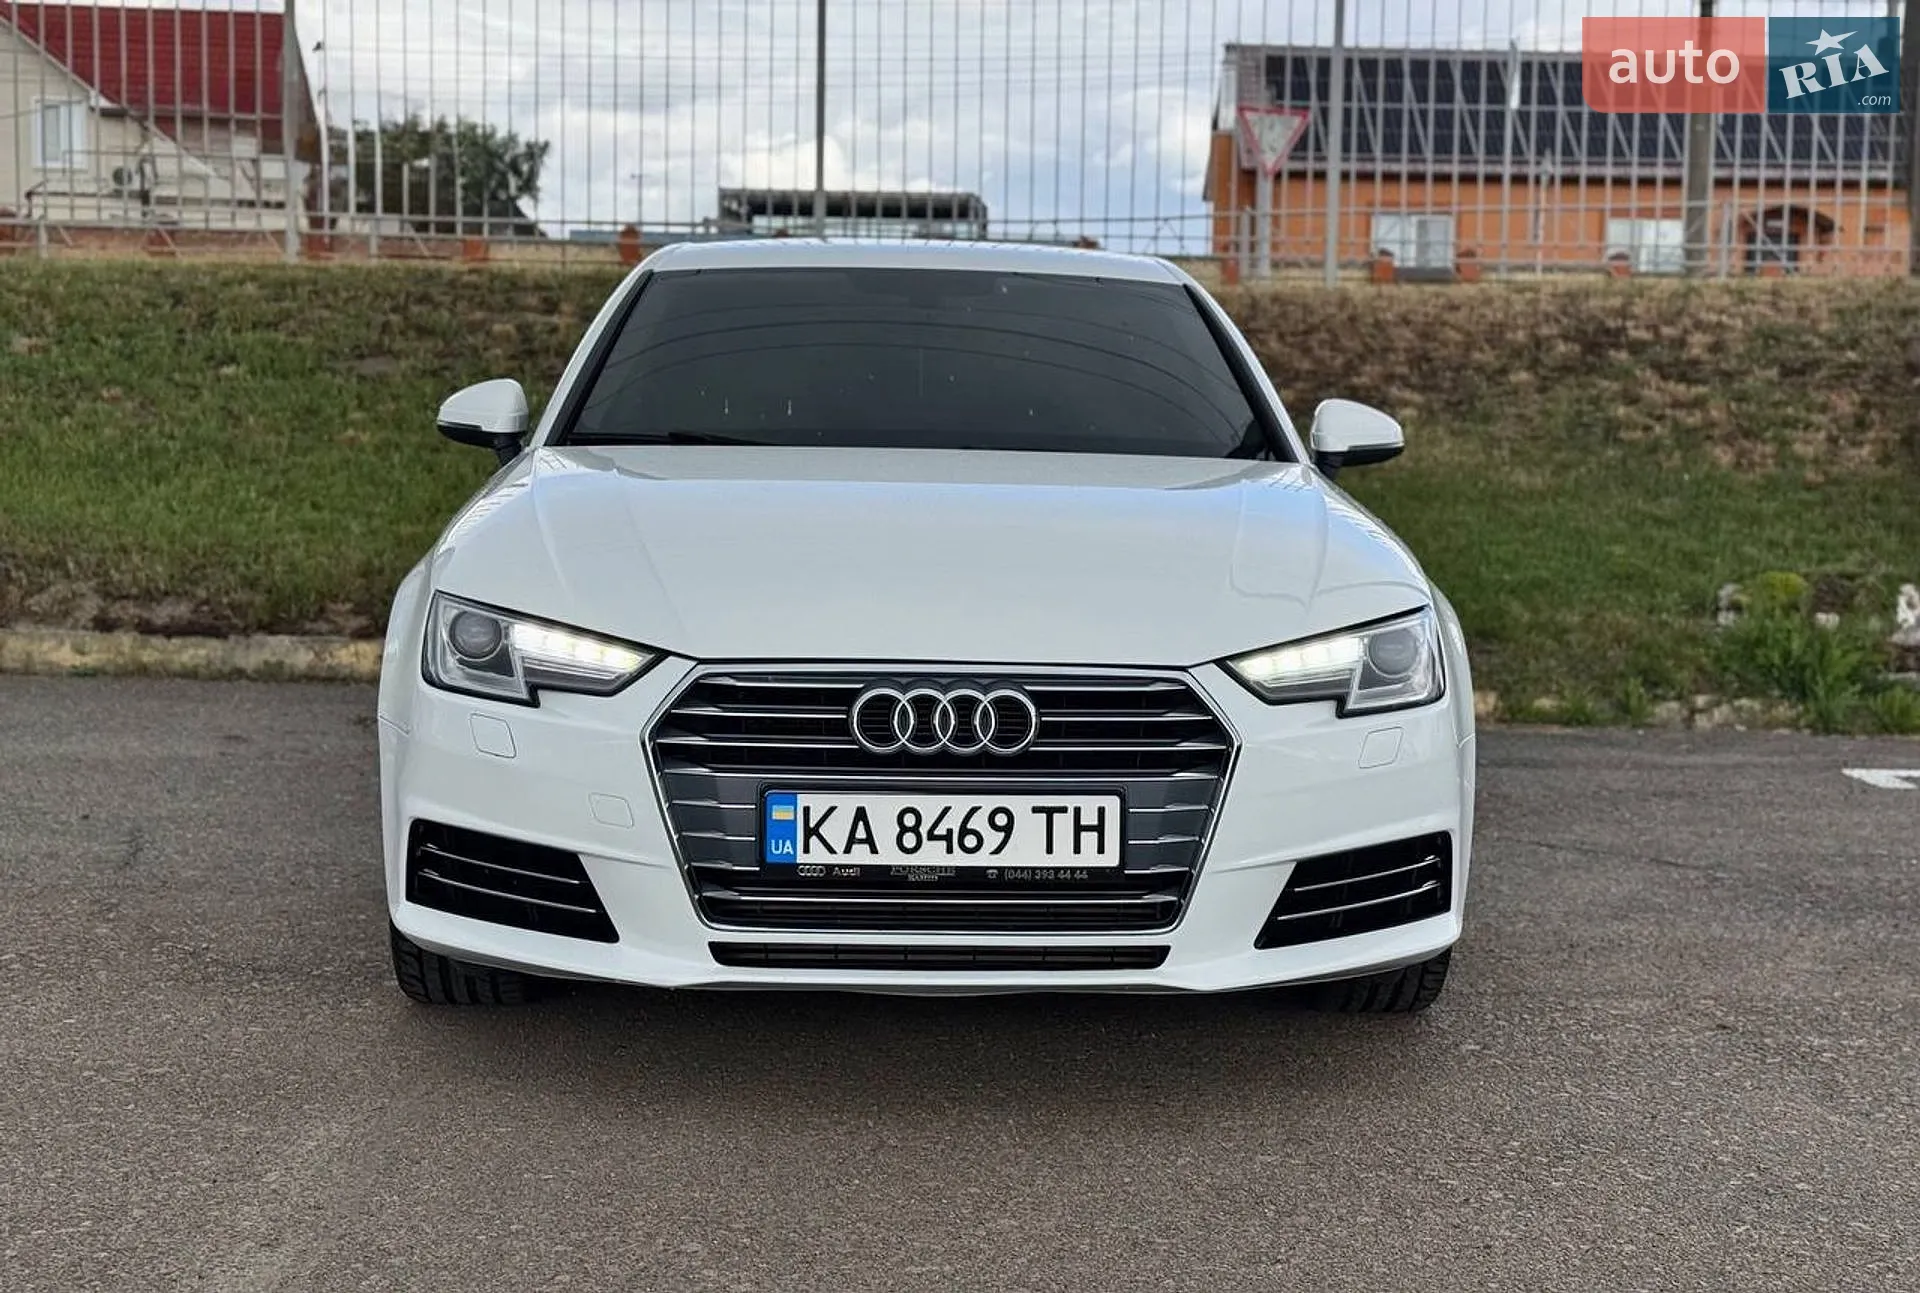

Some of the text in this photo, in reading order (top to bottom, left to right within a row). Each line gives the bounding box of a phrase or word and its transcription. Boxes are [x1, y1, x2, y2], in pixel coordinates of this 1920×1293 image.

[802, 805, 1106, 856] KA 8469 TH
[771, 839, 794, 855] UA
[832, 866, 860, 877] Audi
